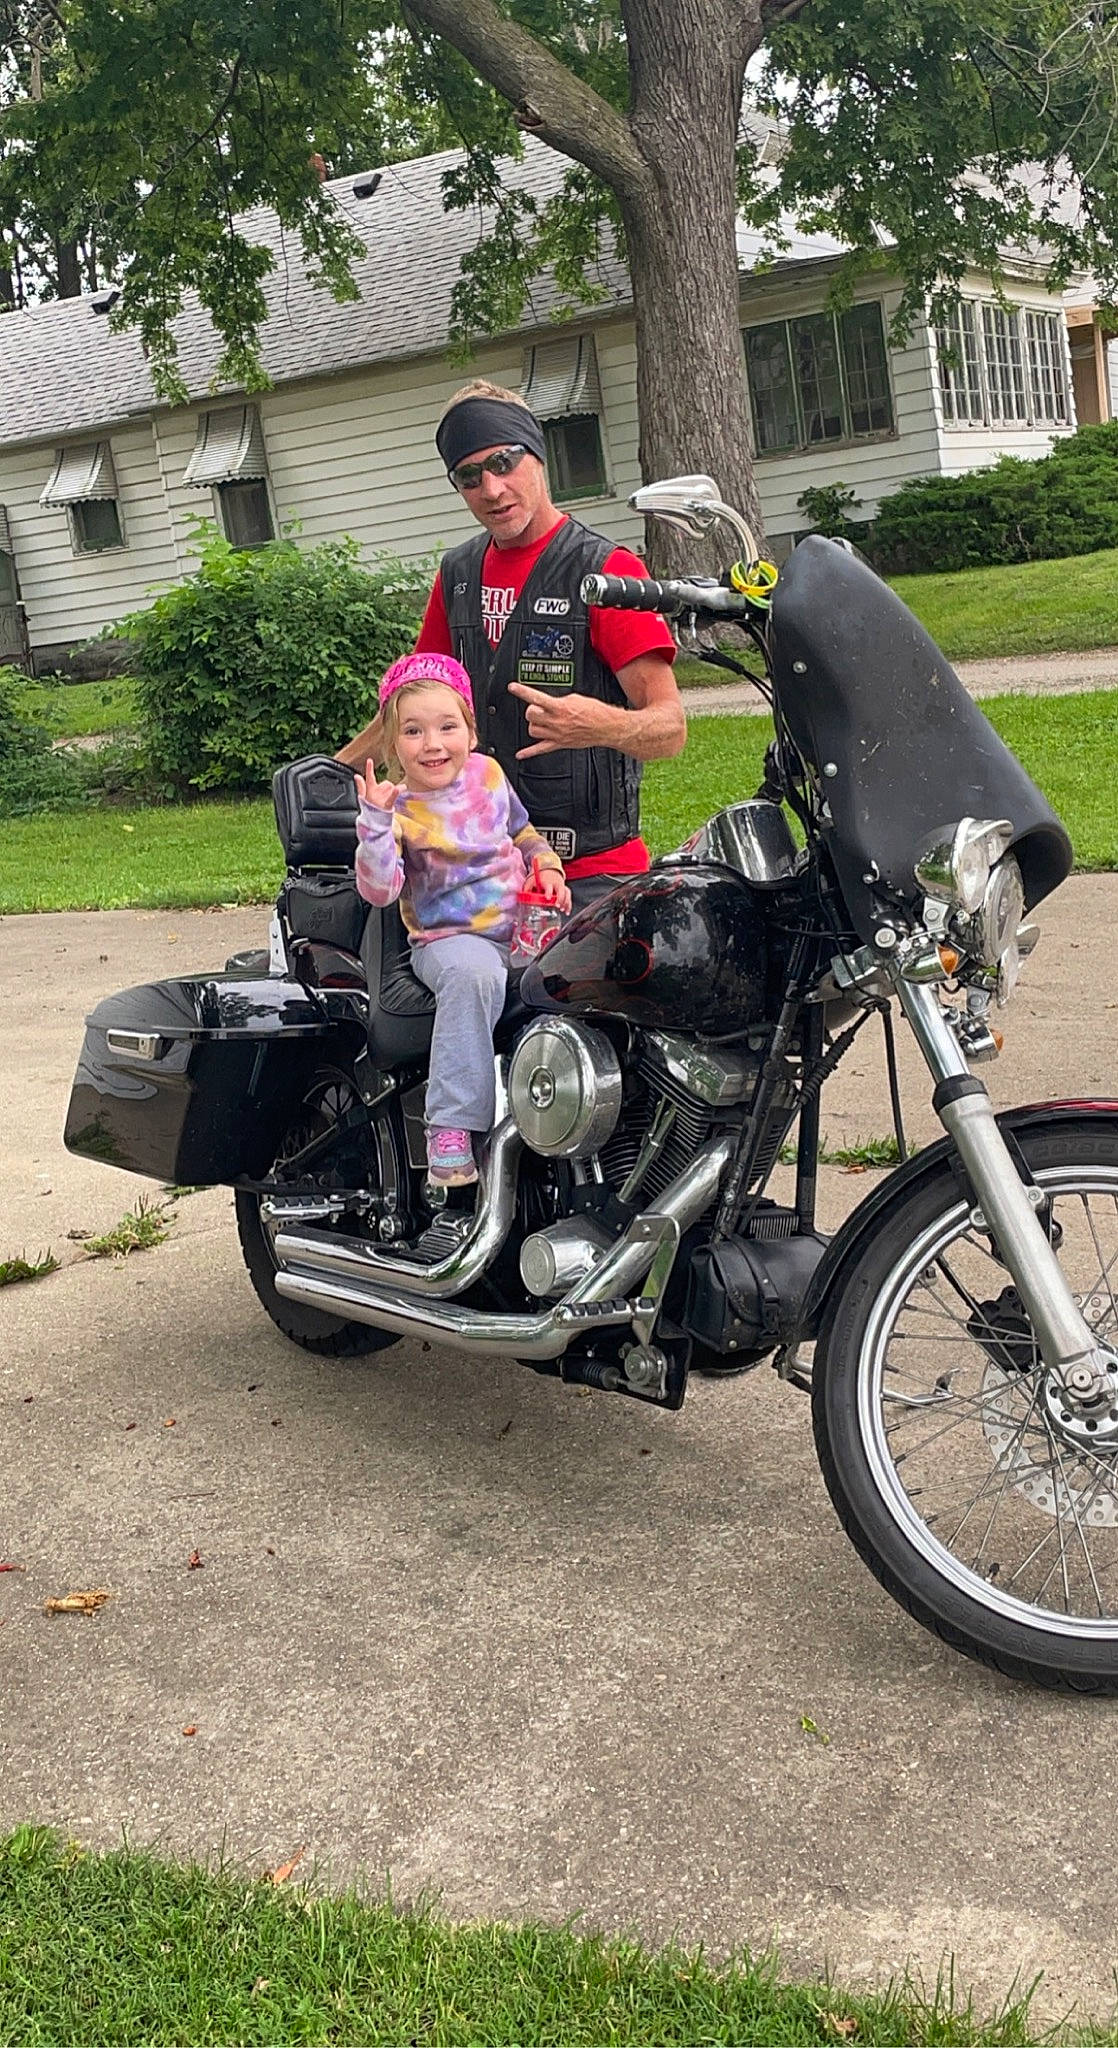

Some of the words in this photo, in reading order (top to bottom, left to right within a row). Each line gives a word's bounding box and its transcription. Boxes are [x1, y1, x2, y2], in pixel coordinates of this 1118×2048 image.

[536, 600, 567, 613] FWC
[521, 663, 535, 672] KEEP
[536, 664, 543, 672] IT
[544, 664, 570, 674] SIMPLE
[546, 673, 570, 682] STONED
[556, 832, 570, 840] DIE
